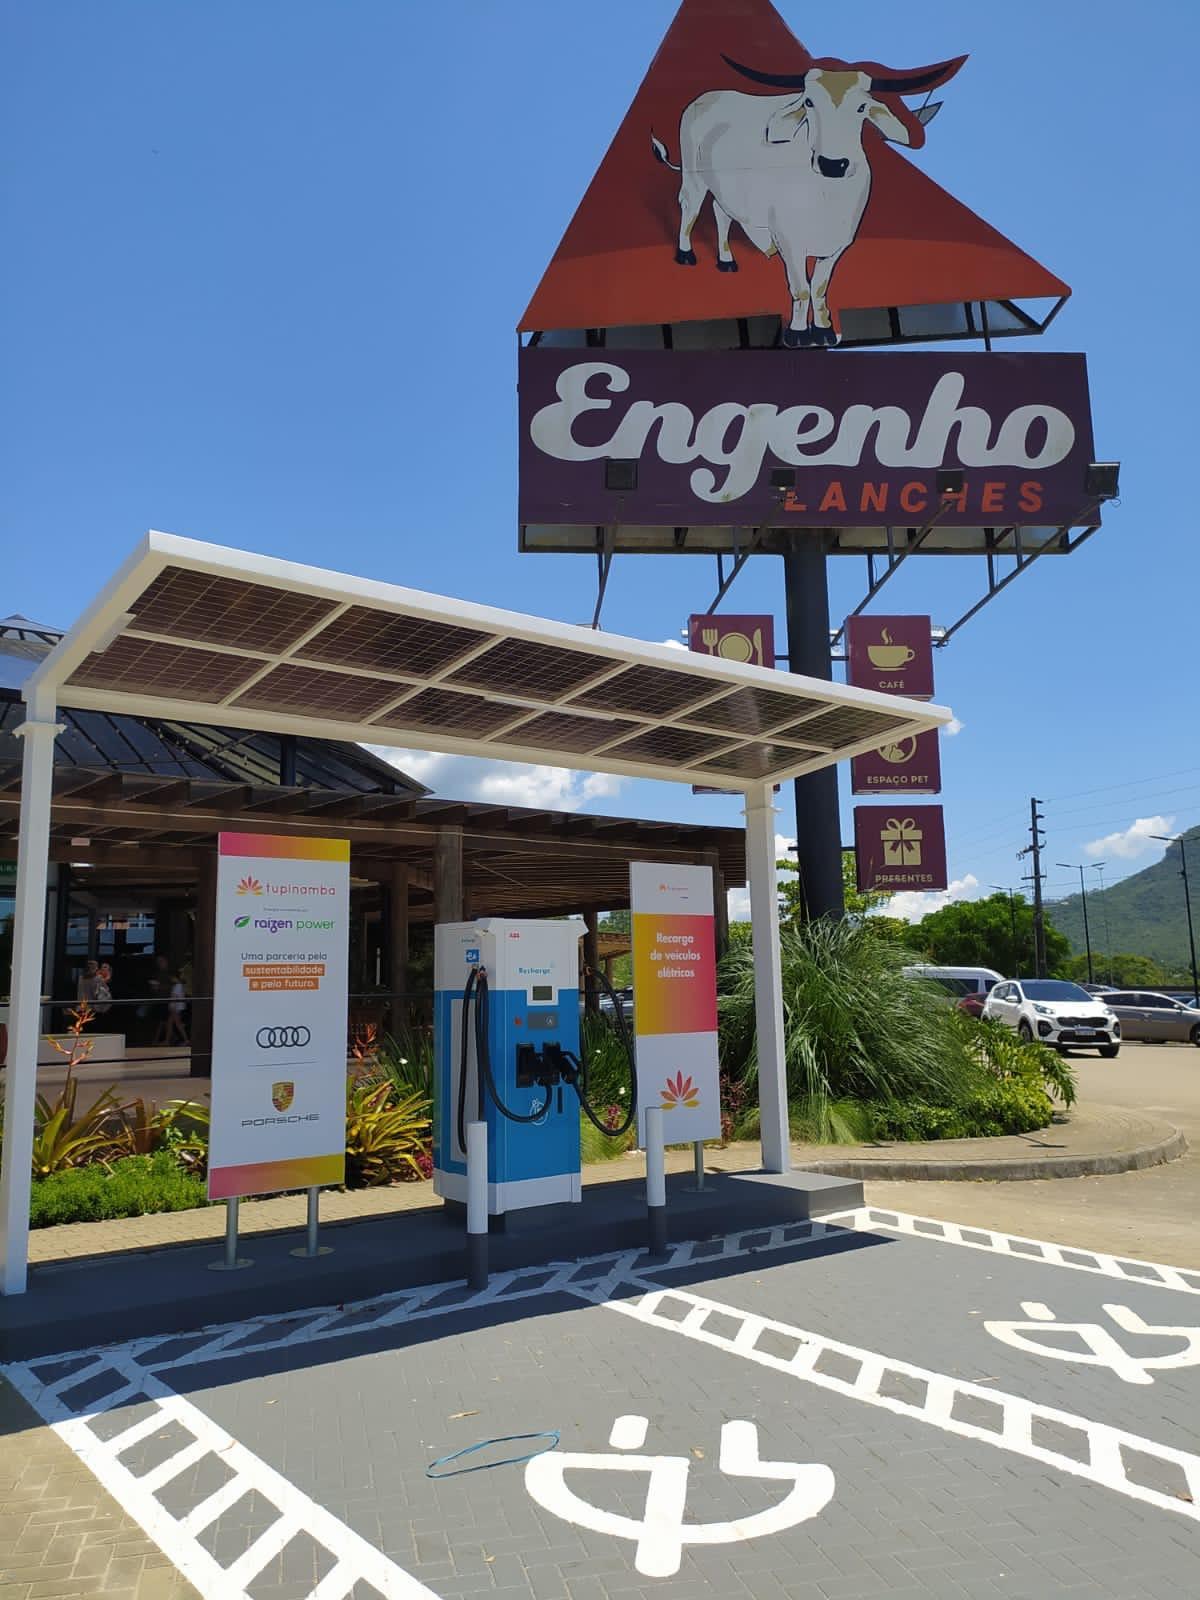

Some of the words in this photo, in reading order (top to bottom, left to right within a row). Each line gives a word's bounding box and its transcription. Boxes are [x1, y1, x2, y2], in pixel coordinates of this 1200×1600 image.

[529, 361, 1076, 503] Engenho
[879, 680, 905, 689] CAFÉ
[867, 775, 908, 786] ESPAÇO
[911, 775, 928, 784] PET
[875, 873, 933, 883] PRESENTES
[296, 919, 335, 931] power
[656, 932, 694, 946] Recarga
[241, 952, 263, 961] Uma
[266, 952, 305, 963] parceria
[650, 949, 662, 960] de
[245, 965, 323, 975] sustentabilidade
[241, 1114, 320, 1126] PORSCHE
